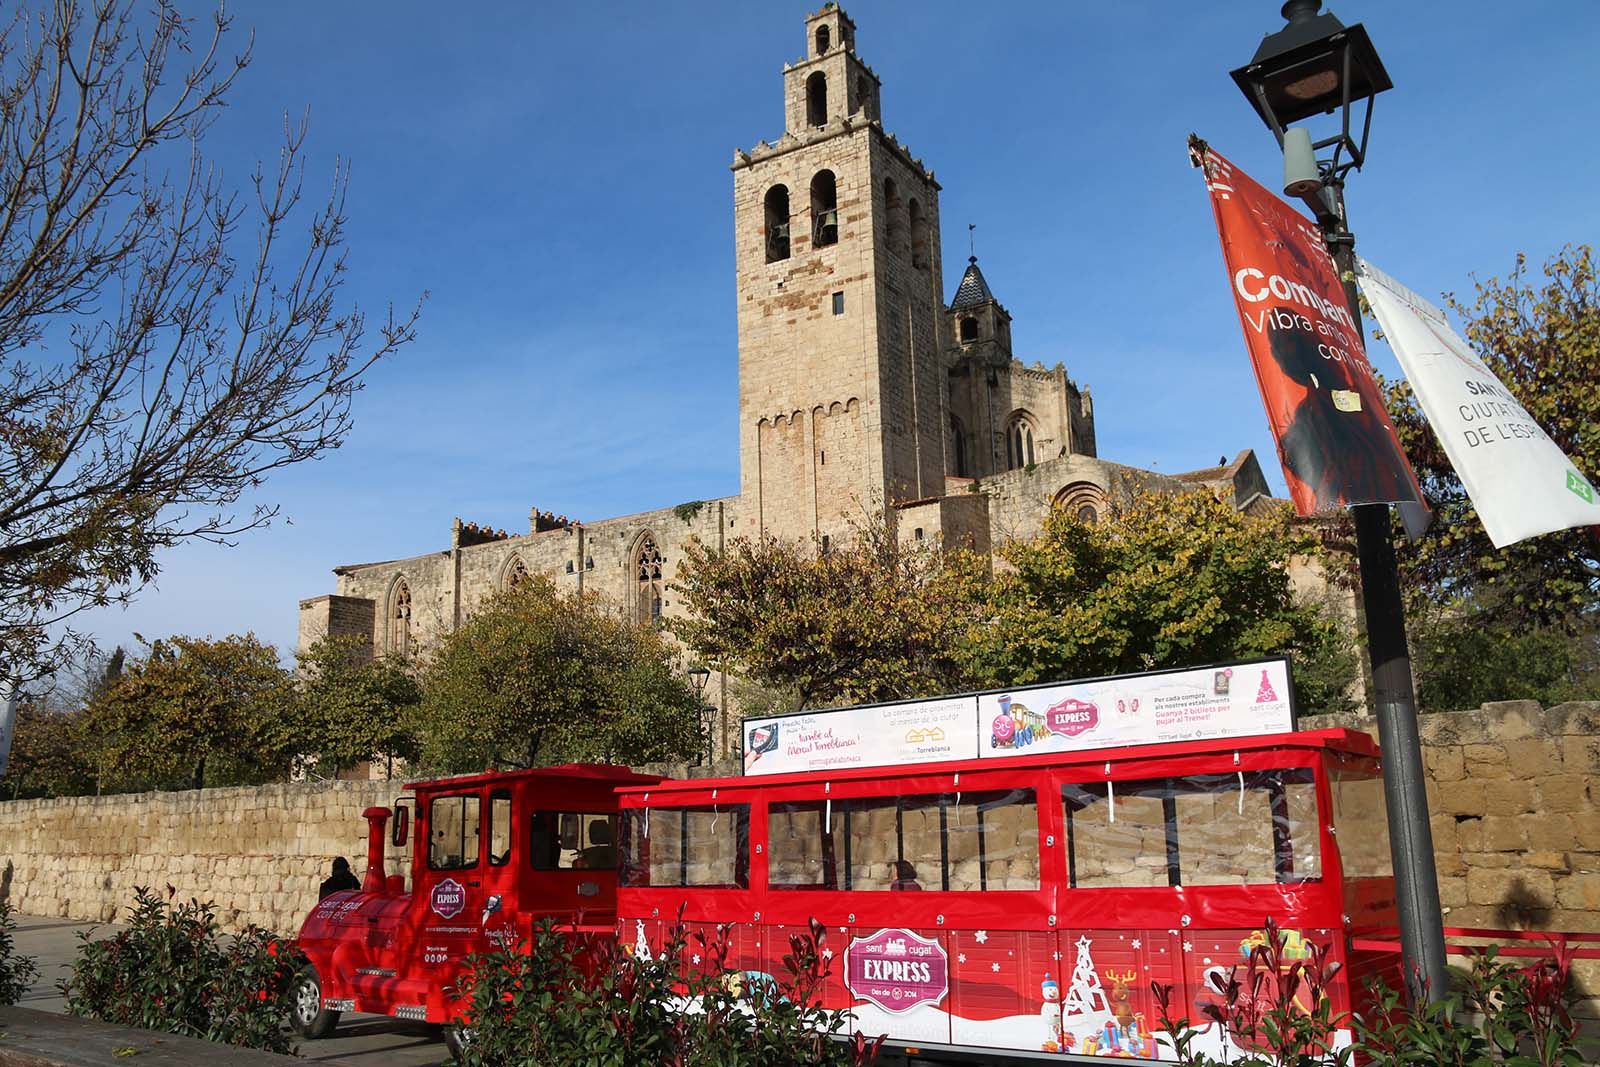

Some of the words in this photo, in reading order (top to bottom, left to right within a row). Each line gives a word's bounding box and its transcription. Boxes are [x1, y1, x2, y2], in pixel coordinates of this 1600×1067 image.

[1245, 307, 1314, 333] Vibra
[1459, 401, 1515, 421] CIUTAT
[1464, 426, 1495, 448] DE
[1495, 423, 1537, 440] L'ESP
[1182, 693, 1206, 701] compra
[1188, 697, 1230, 706] establiments
[1055, 711, 1091, 725] EXPRESS
[1155, 710, 1183, 719] Guanya
[1190, 706, 1217, 715] bitllets
[1218, 705, 1231, 713] per
[1156, 717, 1175, 726] pujar
[824, 728, 834, 740] al
[787, 744, 813, 757] Mercat
[437, 893, 460, 904] EXPRESS
[866, 945, 883, 953] sant
[909, 946, 932, 956] cugat
[864, 960, 931, 983] EXPRESS
[871, 988, 882, 996] Des
[882, 989, 891, 997] de
